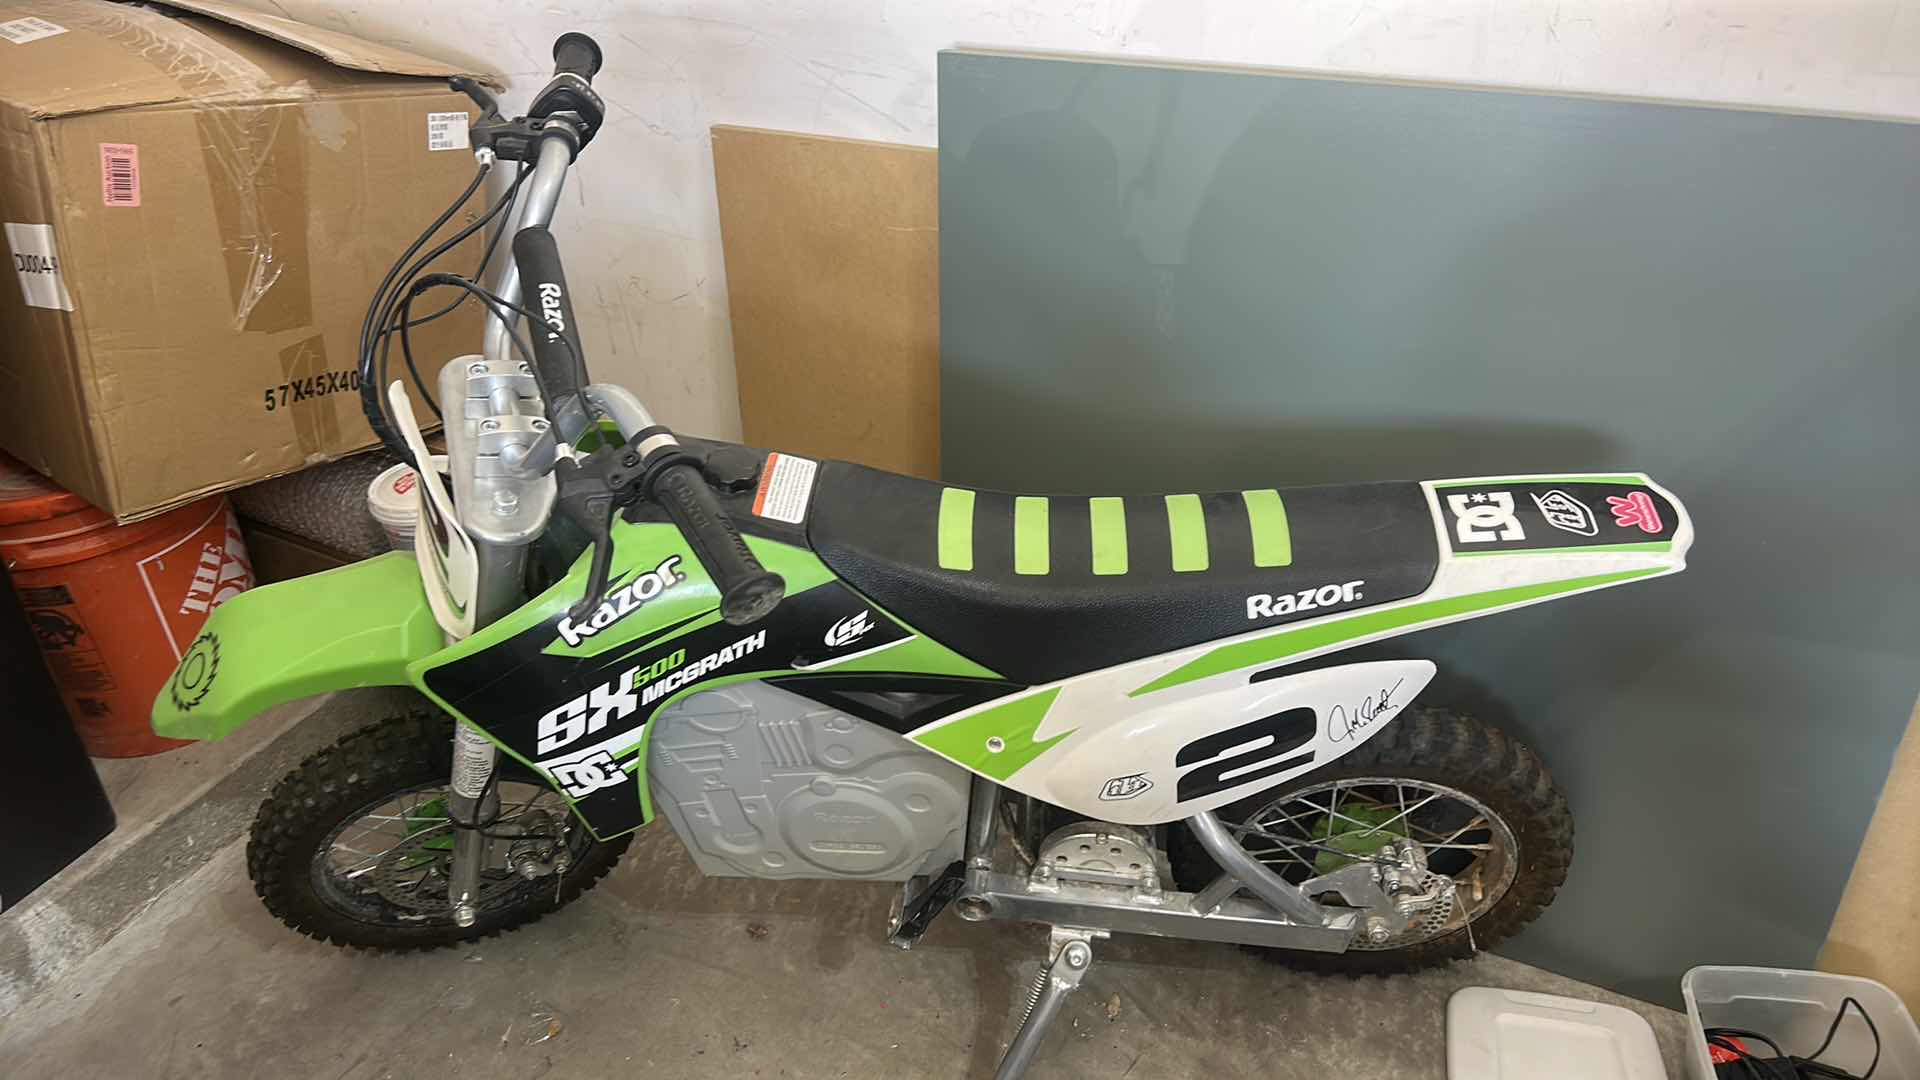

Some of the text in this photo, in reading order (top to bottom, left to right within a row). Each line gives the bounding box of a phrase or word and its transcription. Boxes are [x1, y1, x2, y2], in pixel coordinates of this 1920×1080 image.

[179, 541, 223, 615] THE
[537, 648, 686, 756] SX 500
[641, 630, 767, 706] MCGRATH
[1175, 706, 1318, 804] 2
